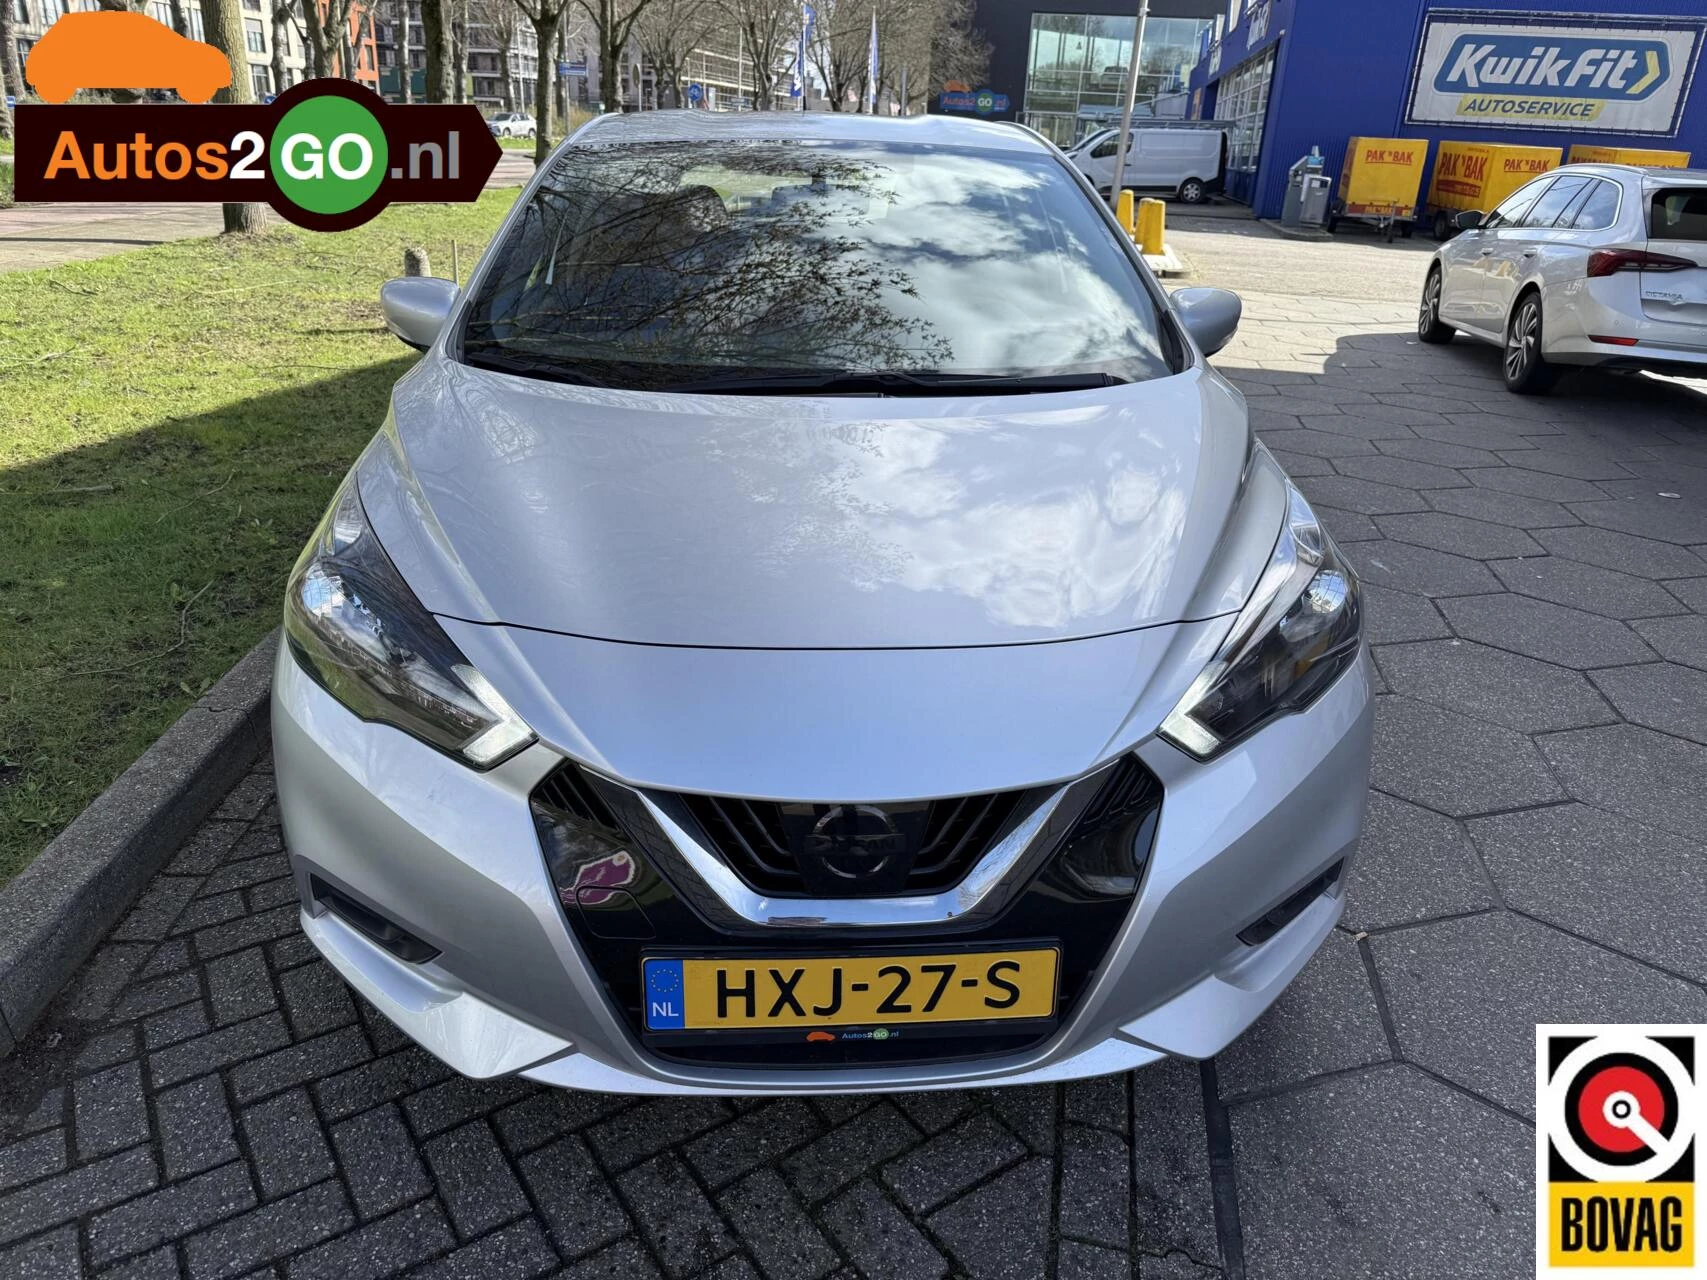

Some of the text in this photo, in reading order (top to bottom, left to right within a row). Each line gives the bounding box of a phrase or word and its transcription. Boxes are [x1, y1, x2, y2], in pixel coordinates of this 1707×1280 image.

[1464, 98, 1595, 117] AUTOSERVICE
[1365, 149, 1386, 161] PAK
[1392, 150, 1414, 163] BAK
[1438, 152, 1461, 177] PAK
[1464, 155, 1488, 182] BAK
[1503, 158, 1523, 171] PAK
[1529, 159, 1551, 172] BAK
[652, 960, 1021, 1018] NL HXJ-27-S
[842, 1029, 899, 1040] Autos2GO.nl
